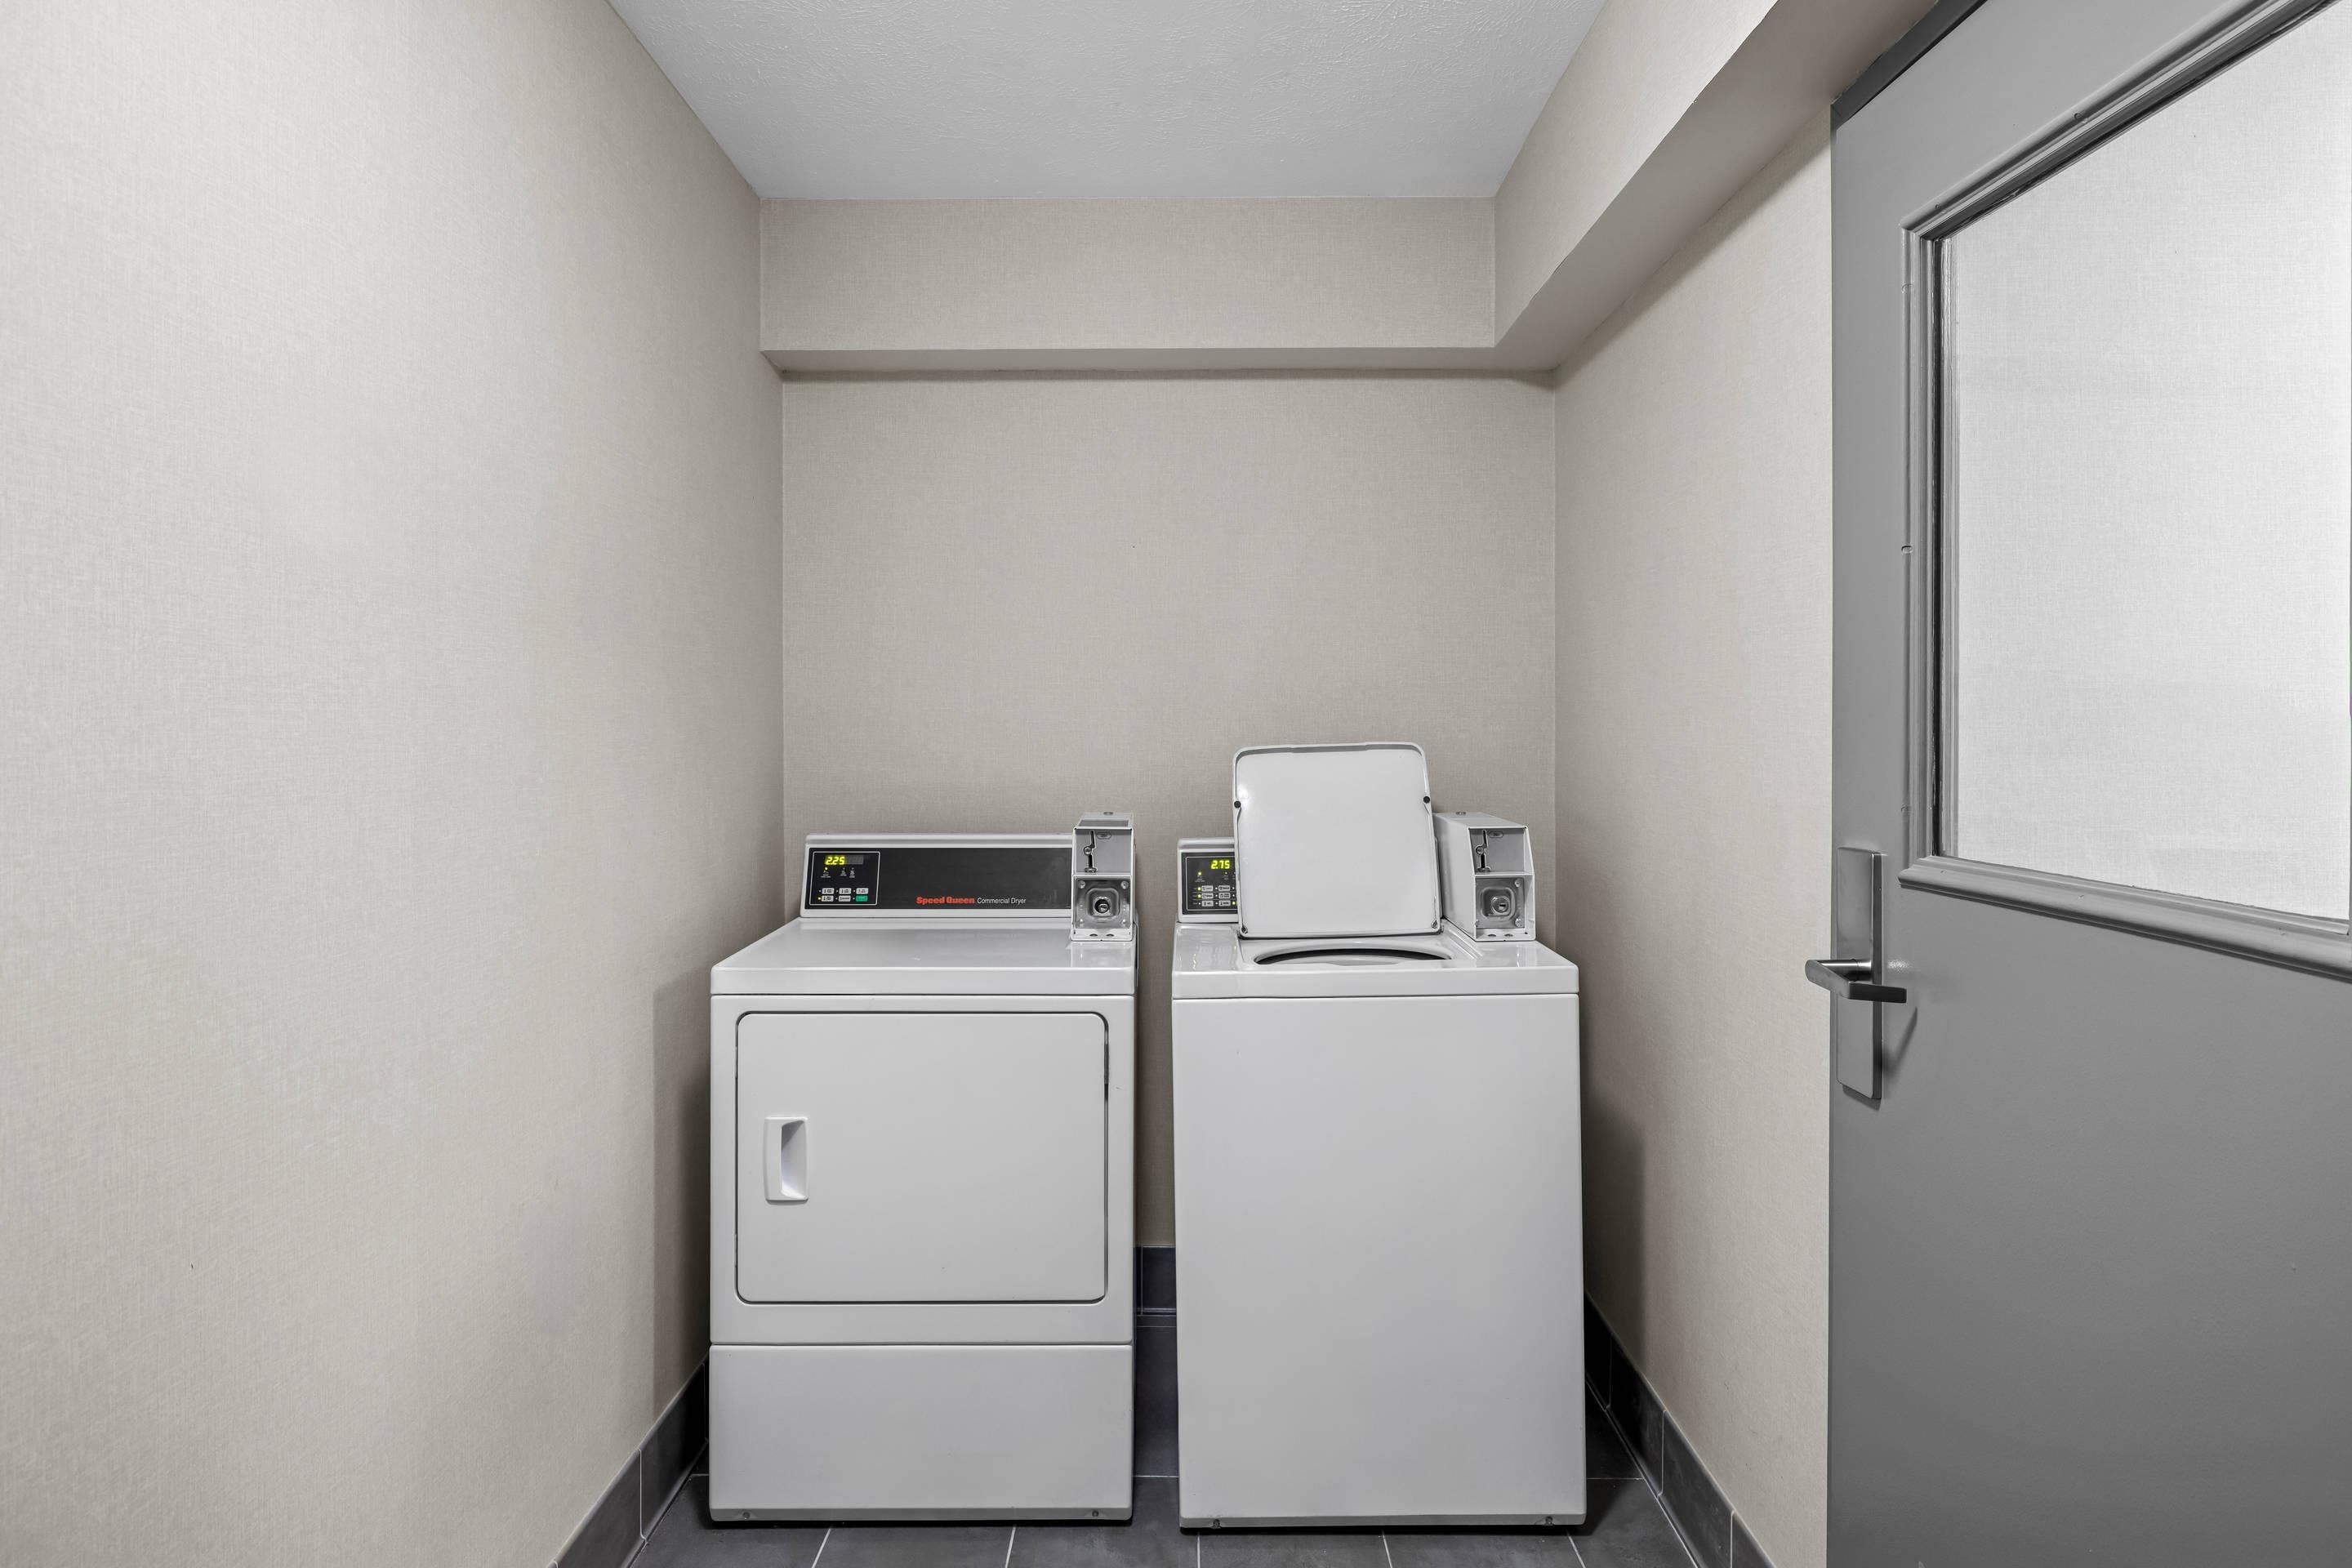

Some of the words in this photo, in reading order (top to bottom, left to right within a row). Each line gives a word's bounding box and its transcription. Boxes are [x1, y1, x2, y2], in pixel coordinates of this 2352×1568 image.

[1210, 860, 1230, 869] 2.75
[916, 897, 945, 905] Speed
[1010, 897, 1027, 905] Dryer
